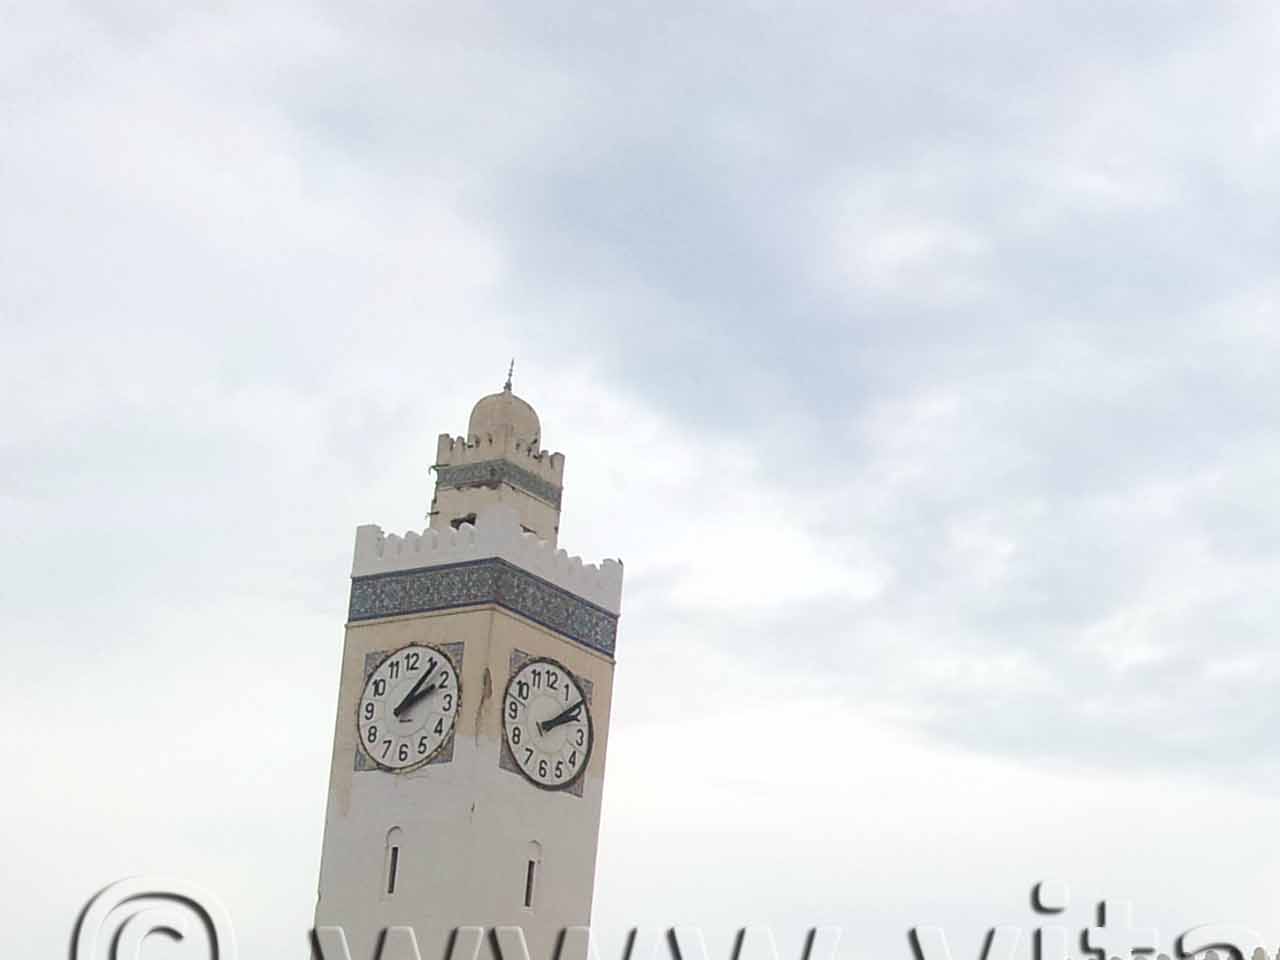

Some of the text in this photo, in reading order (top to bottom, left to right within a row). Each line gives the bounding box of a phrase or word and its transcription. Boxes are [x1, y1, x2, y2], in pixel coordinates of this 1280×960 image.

[388, 661, 400, 679] 11
[404, 653, 420, 671] 12
[372, 679, 386, 697] 10
[439, 671, 449, 689] 2
[531, 669, 542, 689] 11
[545, 670, 559, 690] 12
[516, 680, 530, 700] 10
[564, 684, 569, 701] 1
[364, 703, 374, 720] 9
[443, 694, 452, 712] 3
[508, 702, 518, 720] 9
[368, 726, 377, 743] 8
[434, 718, 443, 736] 4
[512, 727, 521, 744] 8
[418, 736, 428, 754] 5
[576, 729, 584, 746] 3
[382, 740, 392, 759] 7
[398, 744, 408, 761] 6
[524, 748, 534, 766] 7
[568, 750, 577, 768] 4
[539, 760, 548, 778] 6
[555, 761, 563, 778] 5
